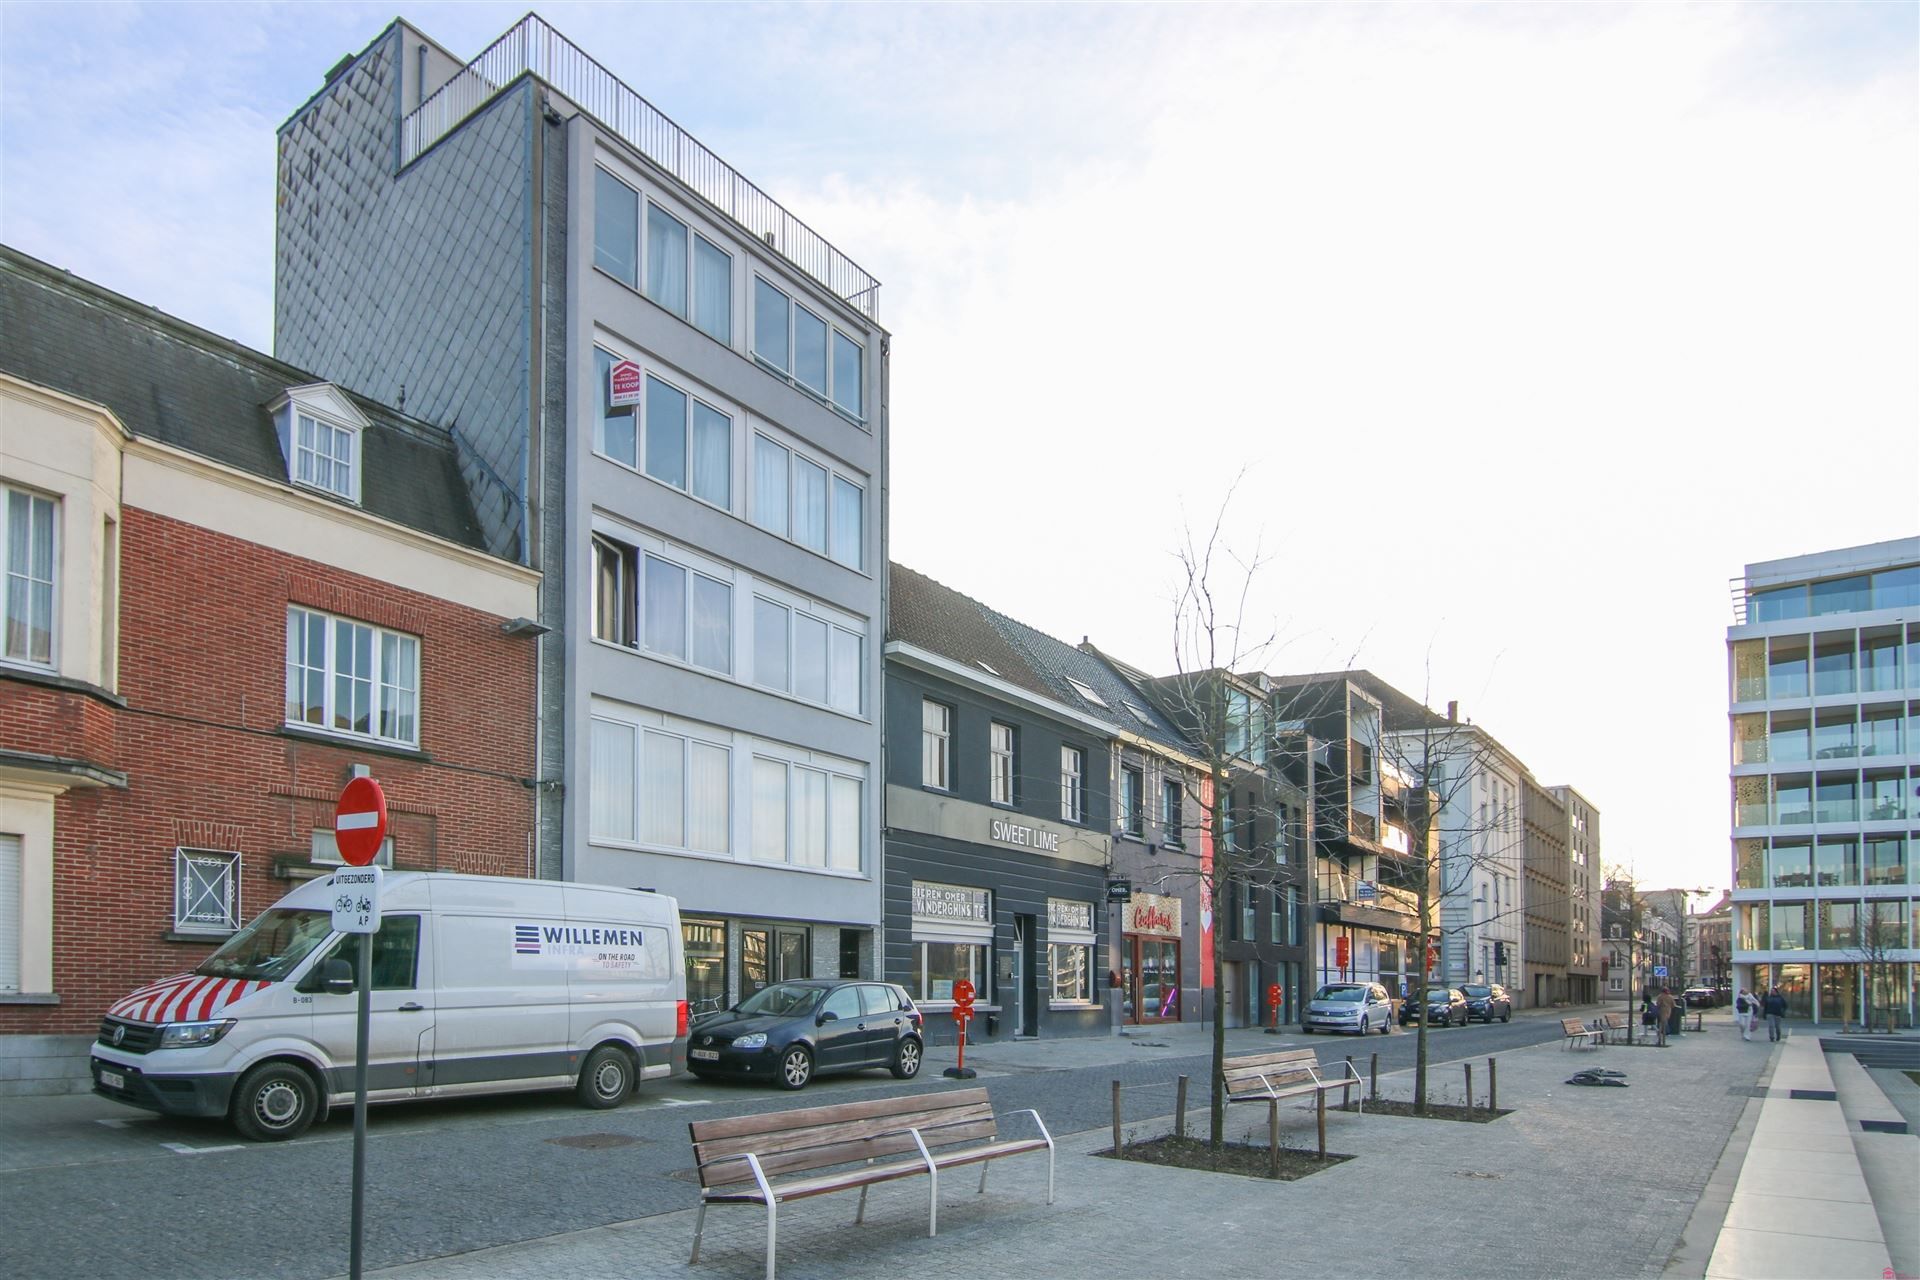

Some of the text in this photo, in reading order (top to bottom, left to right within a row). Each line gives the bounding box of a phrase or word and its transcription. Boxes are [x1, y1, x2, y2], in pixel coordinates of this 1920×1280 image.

[622, 381, 640, 389] KOOP
[993, 820, 1059, 852] SWEET LIME
[335, 873, 376, 884] UITGEZONDERD
[945, 891, 966, 903] OMER
[358, 915, 369, 926] A P
[543, 926, 643, 946] WILLEMEN
[548, 944, 585, 956] INFRA
[598, 952, 636, 962] ON THE ROAD
[610, 961, 632, 969] SAFETY
